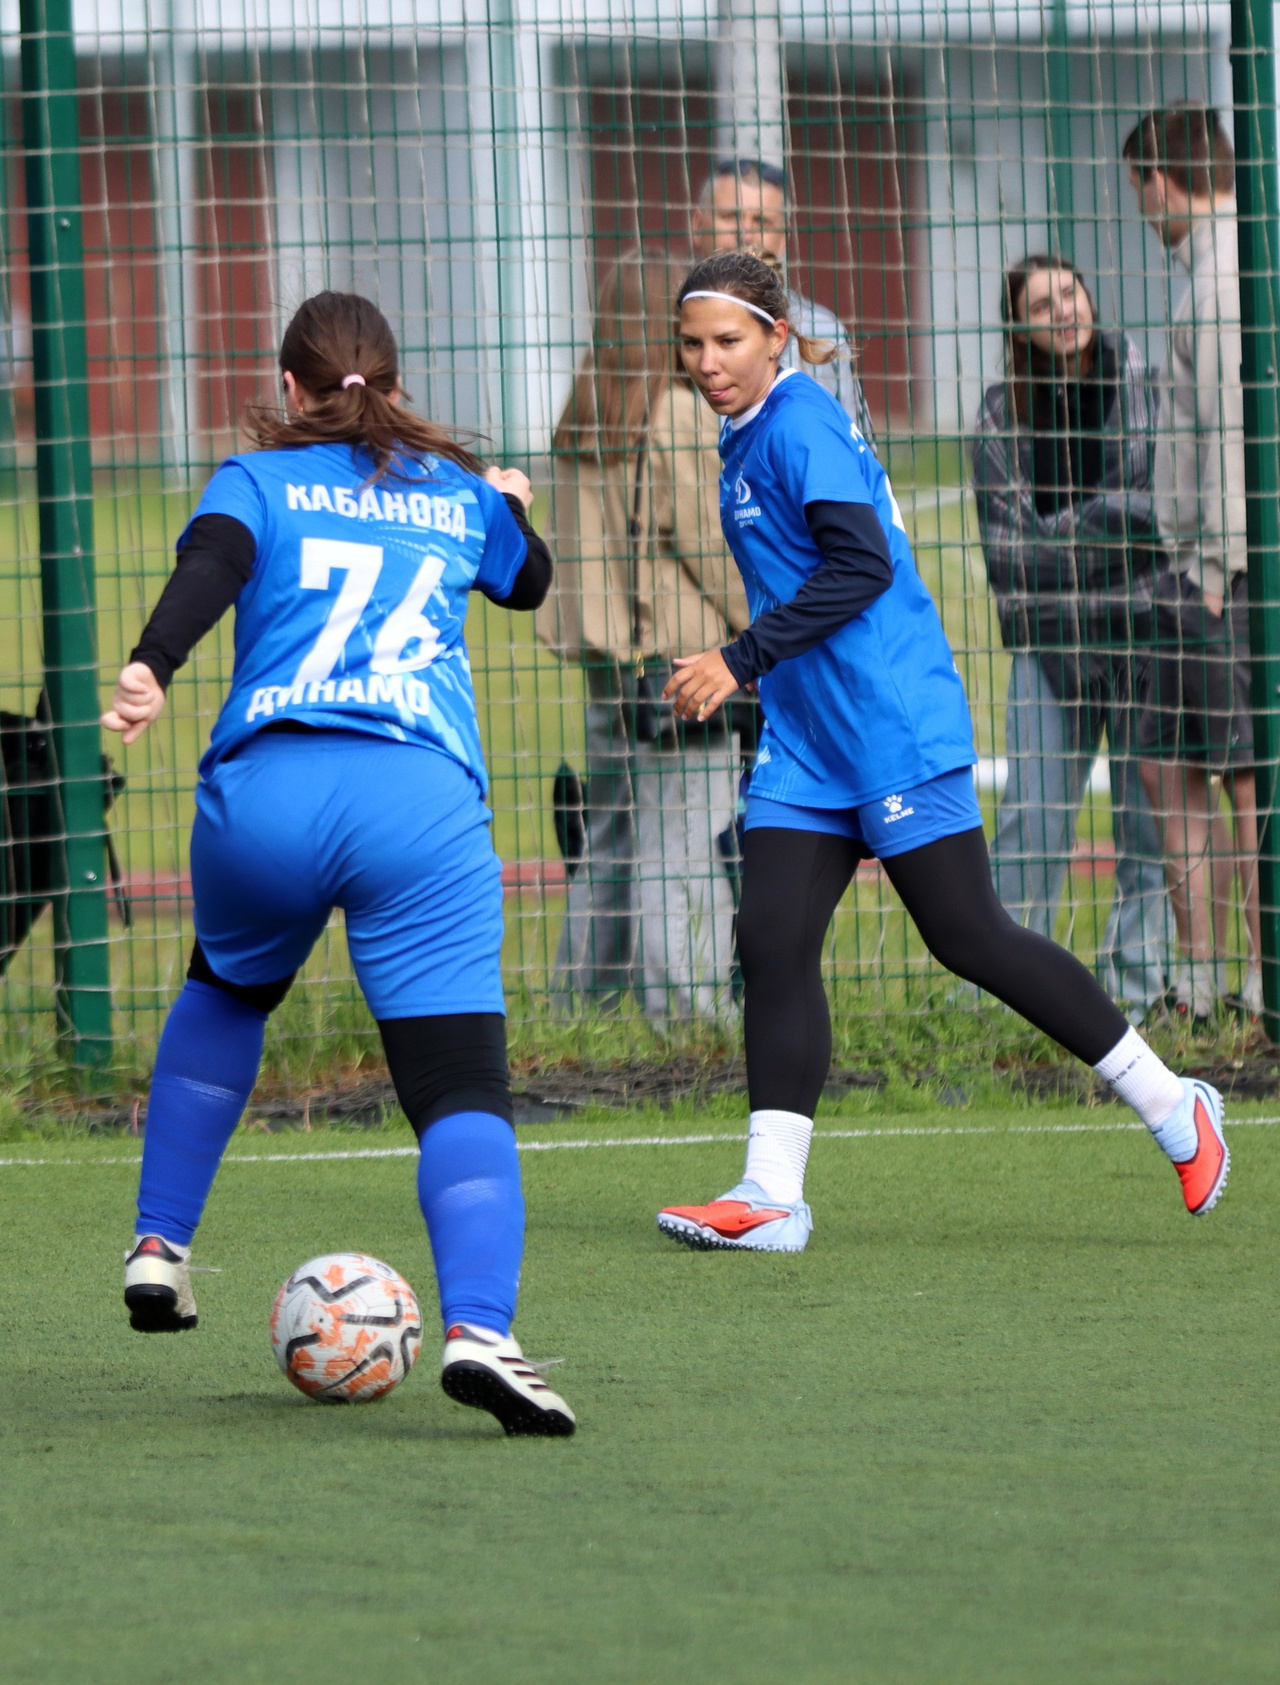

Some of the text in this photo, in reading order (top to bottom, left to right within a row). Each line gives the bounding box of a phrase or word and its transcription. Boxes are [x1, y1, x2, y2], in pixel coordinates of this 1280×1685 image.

[286, 482, 467, 543] КАБАНОВА
[292, 537, 448, 685] 76
[245, 675, 431, 723] ДИНАМО
[883, 807, 915, 824] KELME
